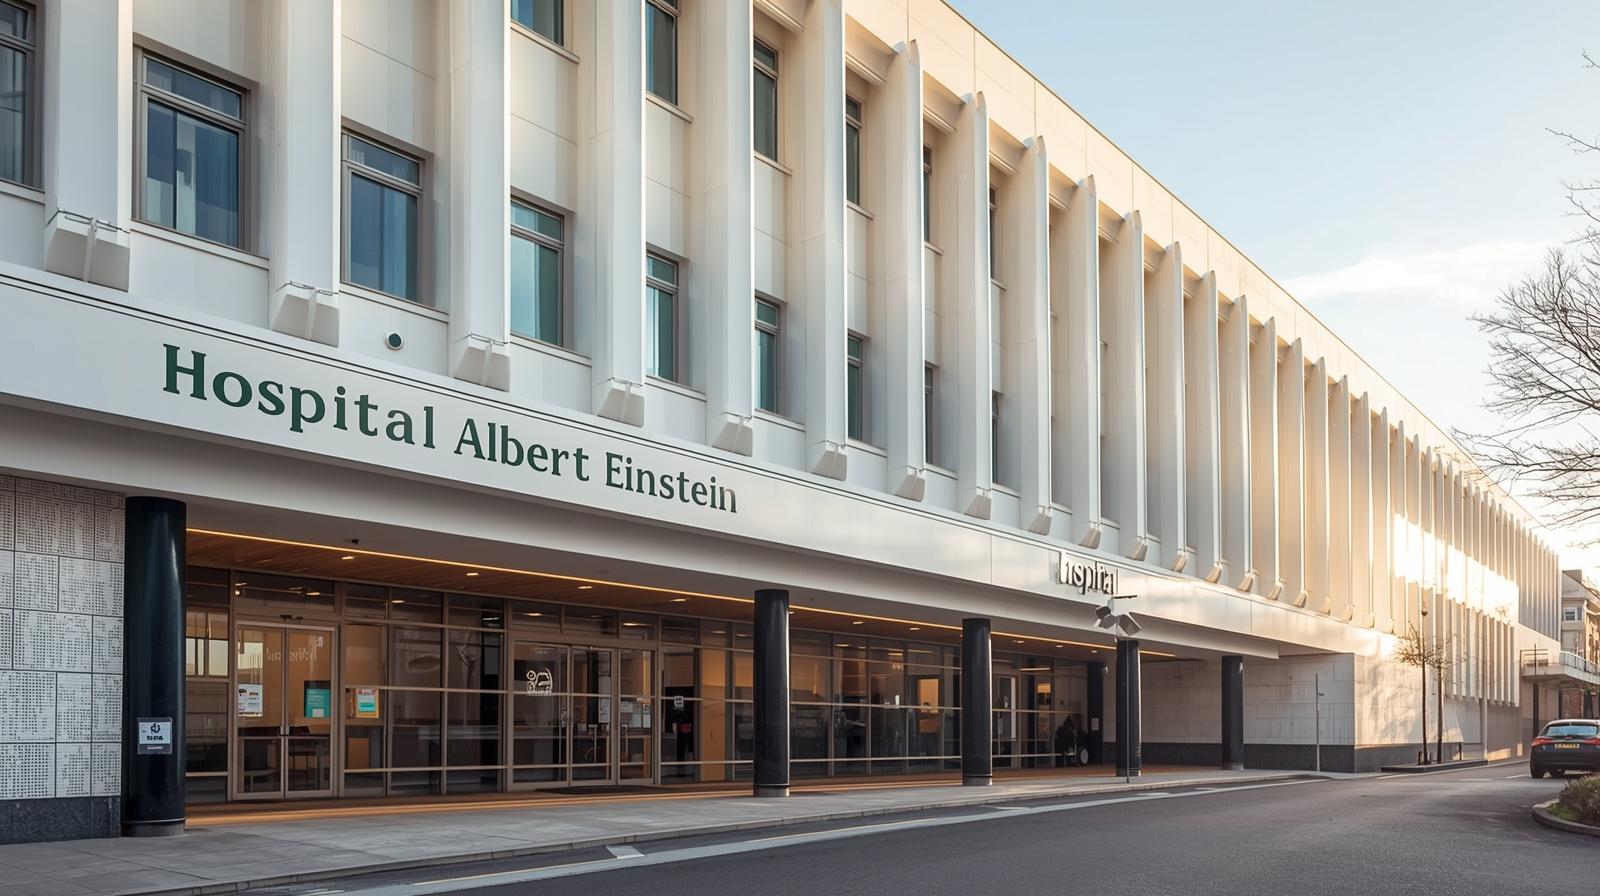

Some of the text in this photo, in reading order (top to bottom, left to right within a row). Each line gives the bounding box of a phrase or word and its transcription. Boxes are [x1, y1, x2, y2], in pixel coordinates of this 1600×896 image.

[163, 343, 738, 513] Hospital Albert Einstein
